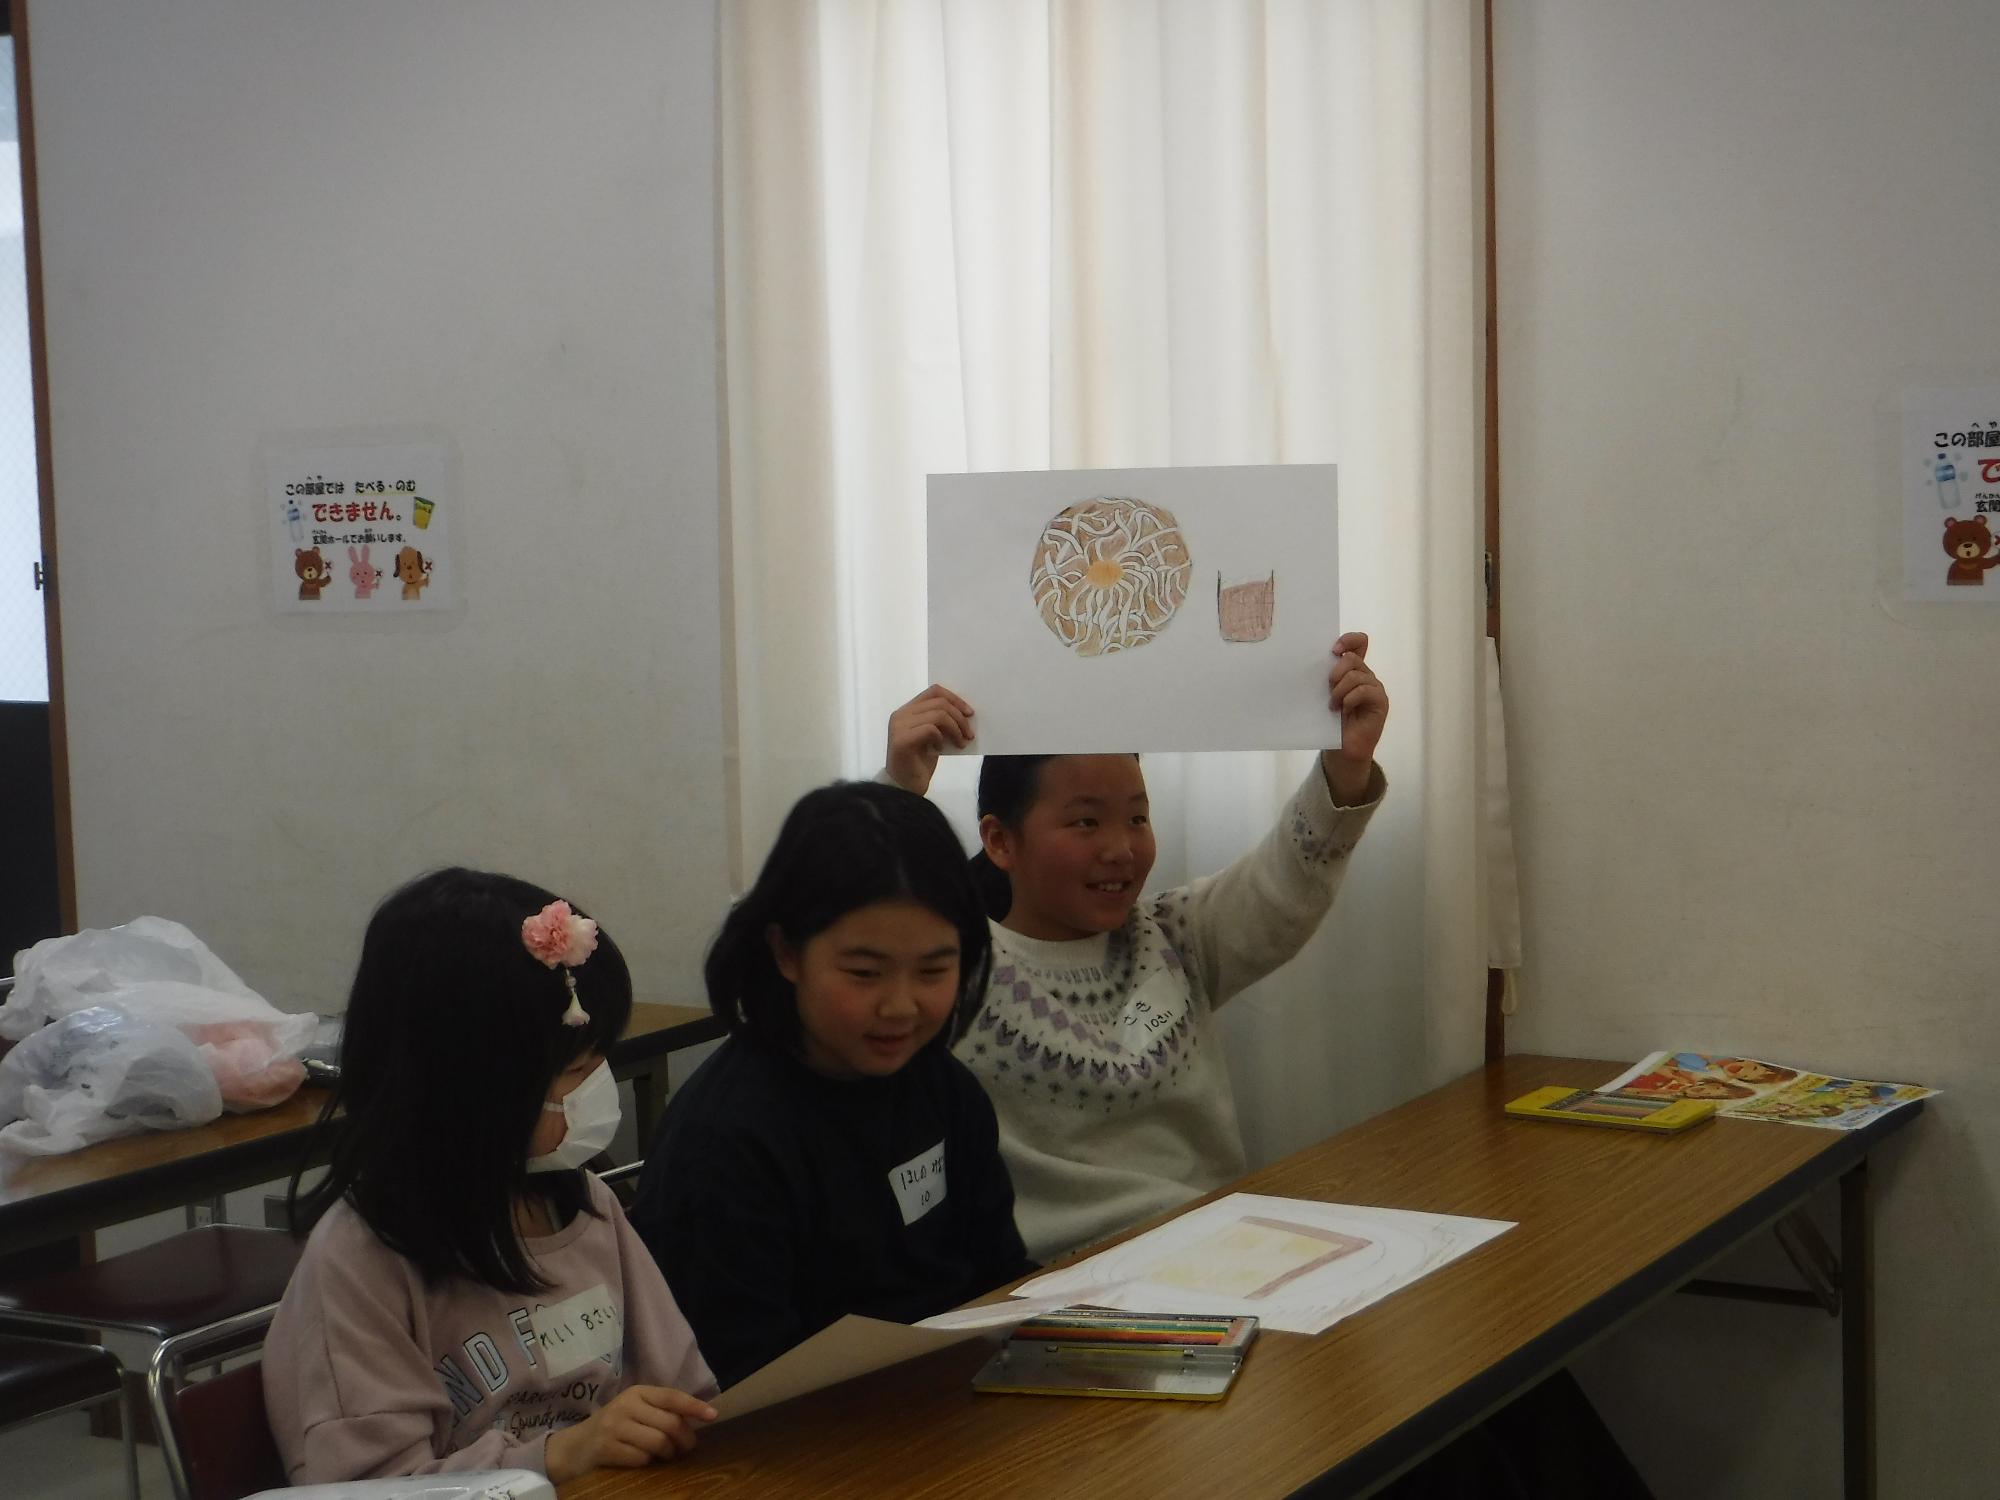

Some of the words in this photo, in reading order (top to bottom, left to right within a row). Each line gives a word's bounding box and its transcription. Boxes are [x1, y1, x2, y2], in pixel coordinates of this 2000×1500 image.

[286, 482, 344, 496] この部屋では
